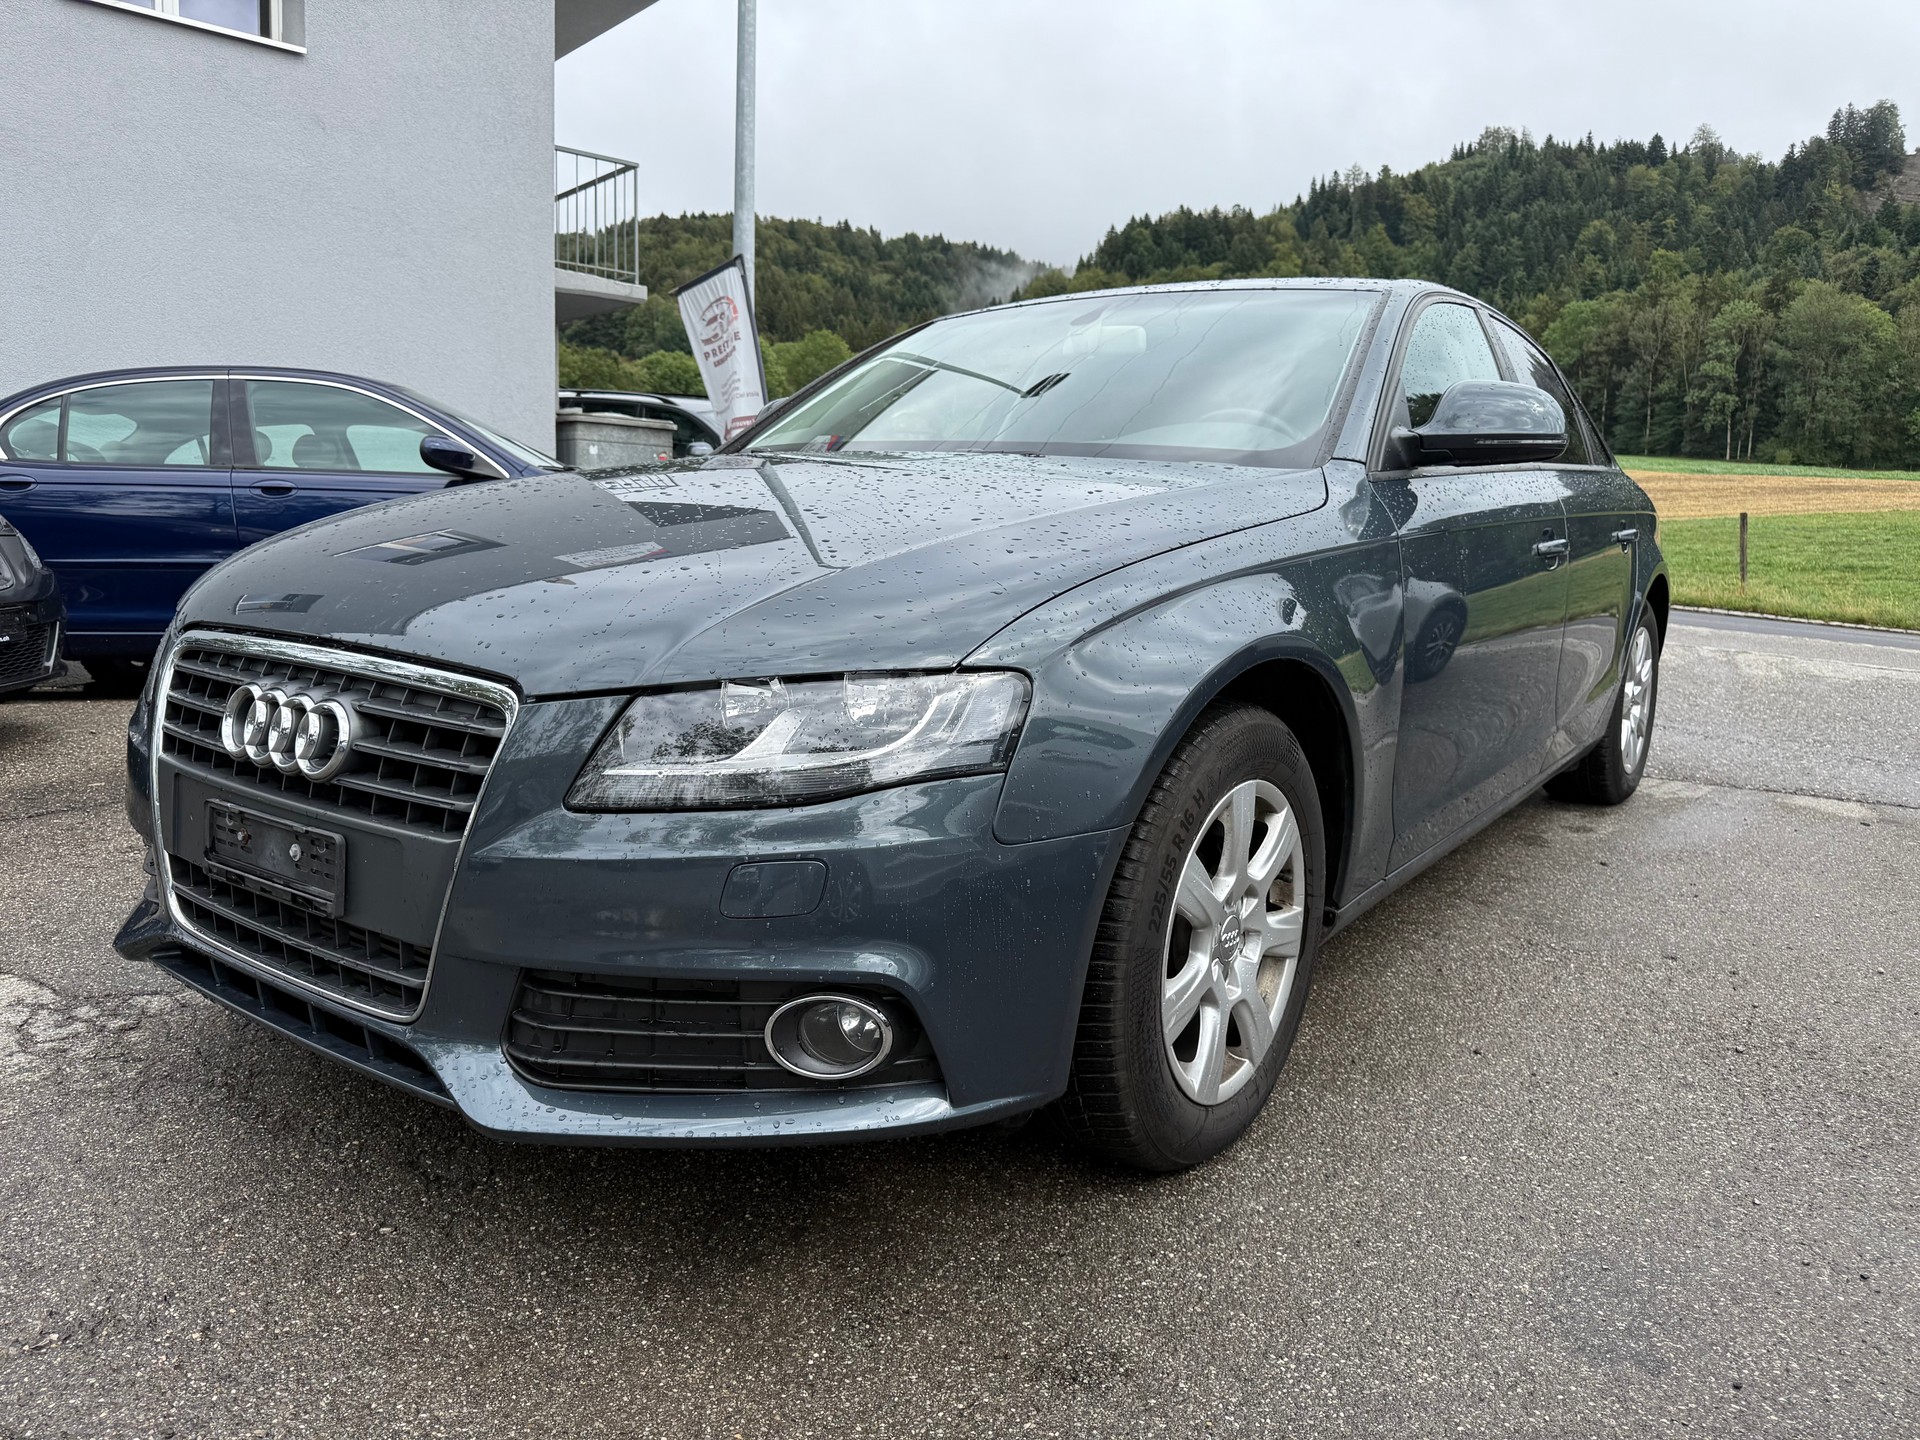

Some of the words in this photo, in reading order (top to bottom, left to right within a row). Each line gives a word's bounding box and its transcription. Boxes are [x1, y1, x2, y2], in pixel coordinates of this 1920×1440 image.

[703, 331, 742, 361] PRESTE
[1148, 854, 1177, 934] 225/55
[1172, 834, 1186, 852] R
[1180, 810, 1195, 834] 16
[1192, 788, 1207, 810] H
